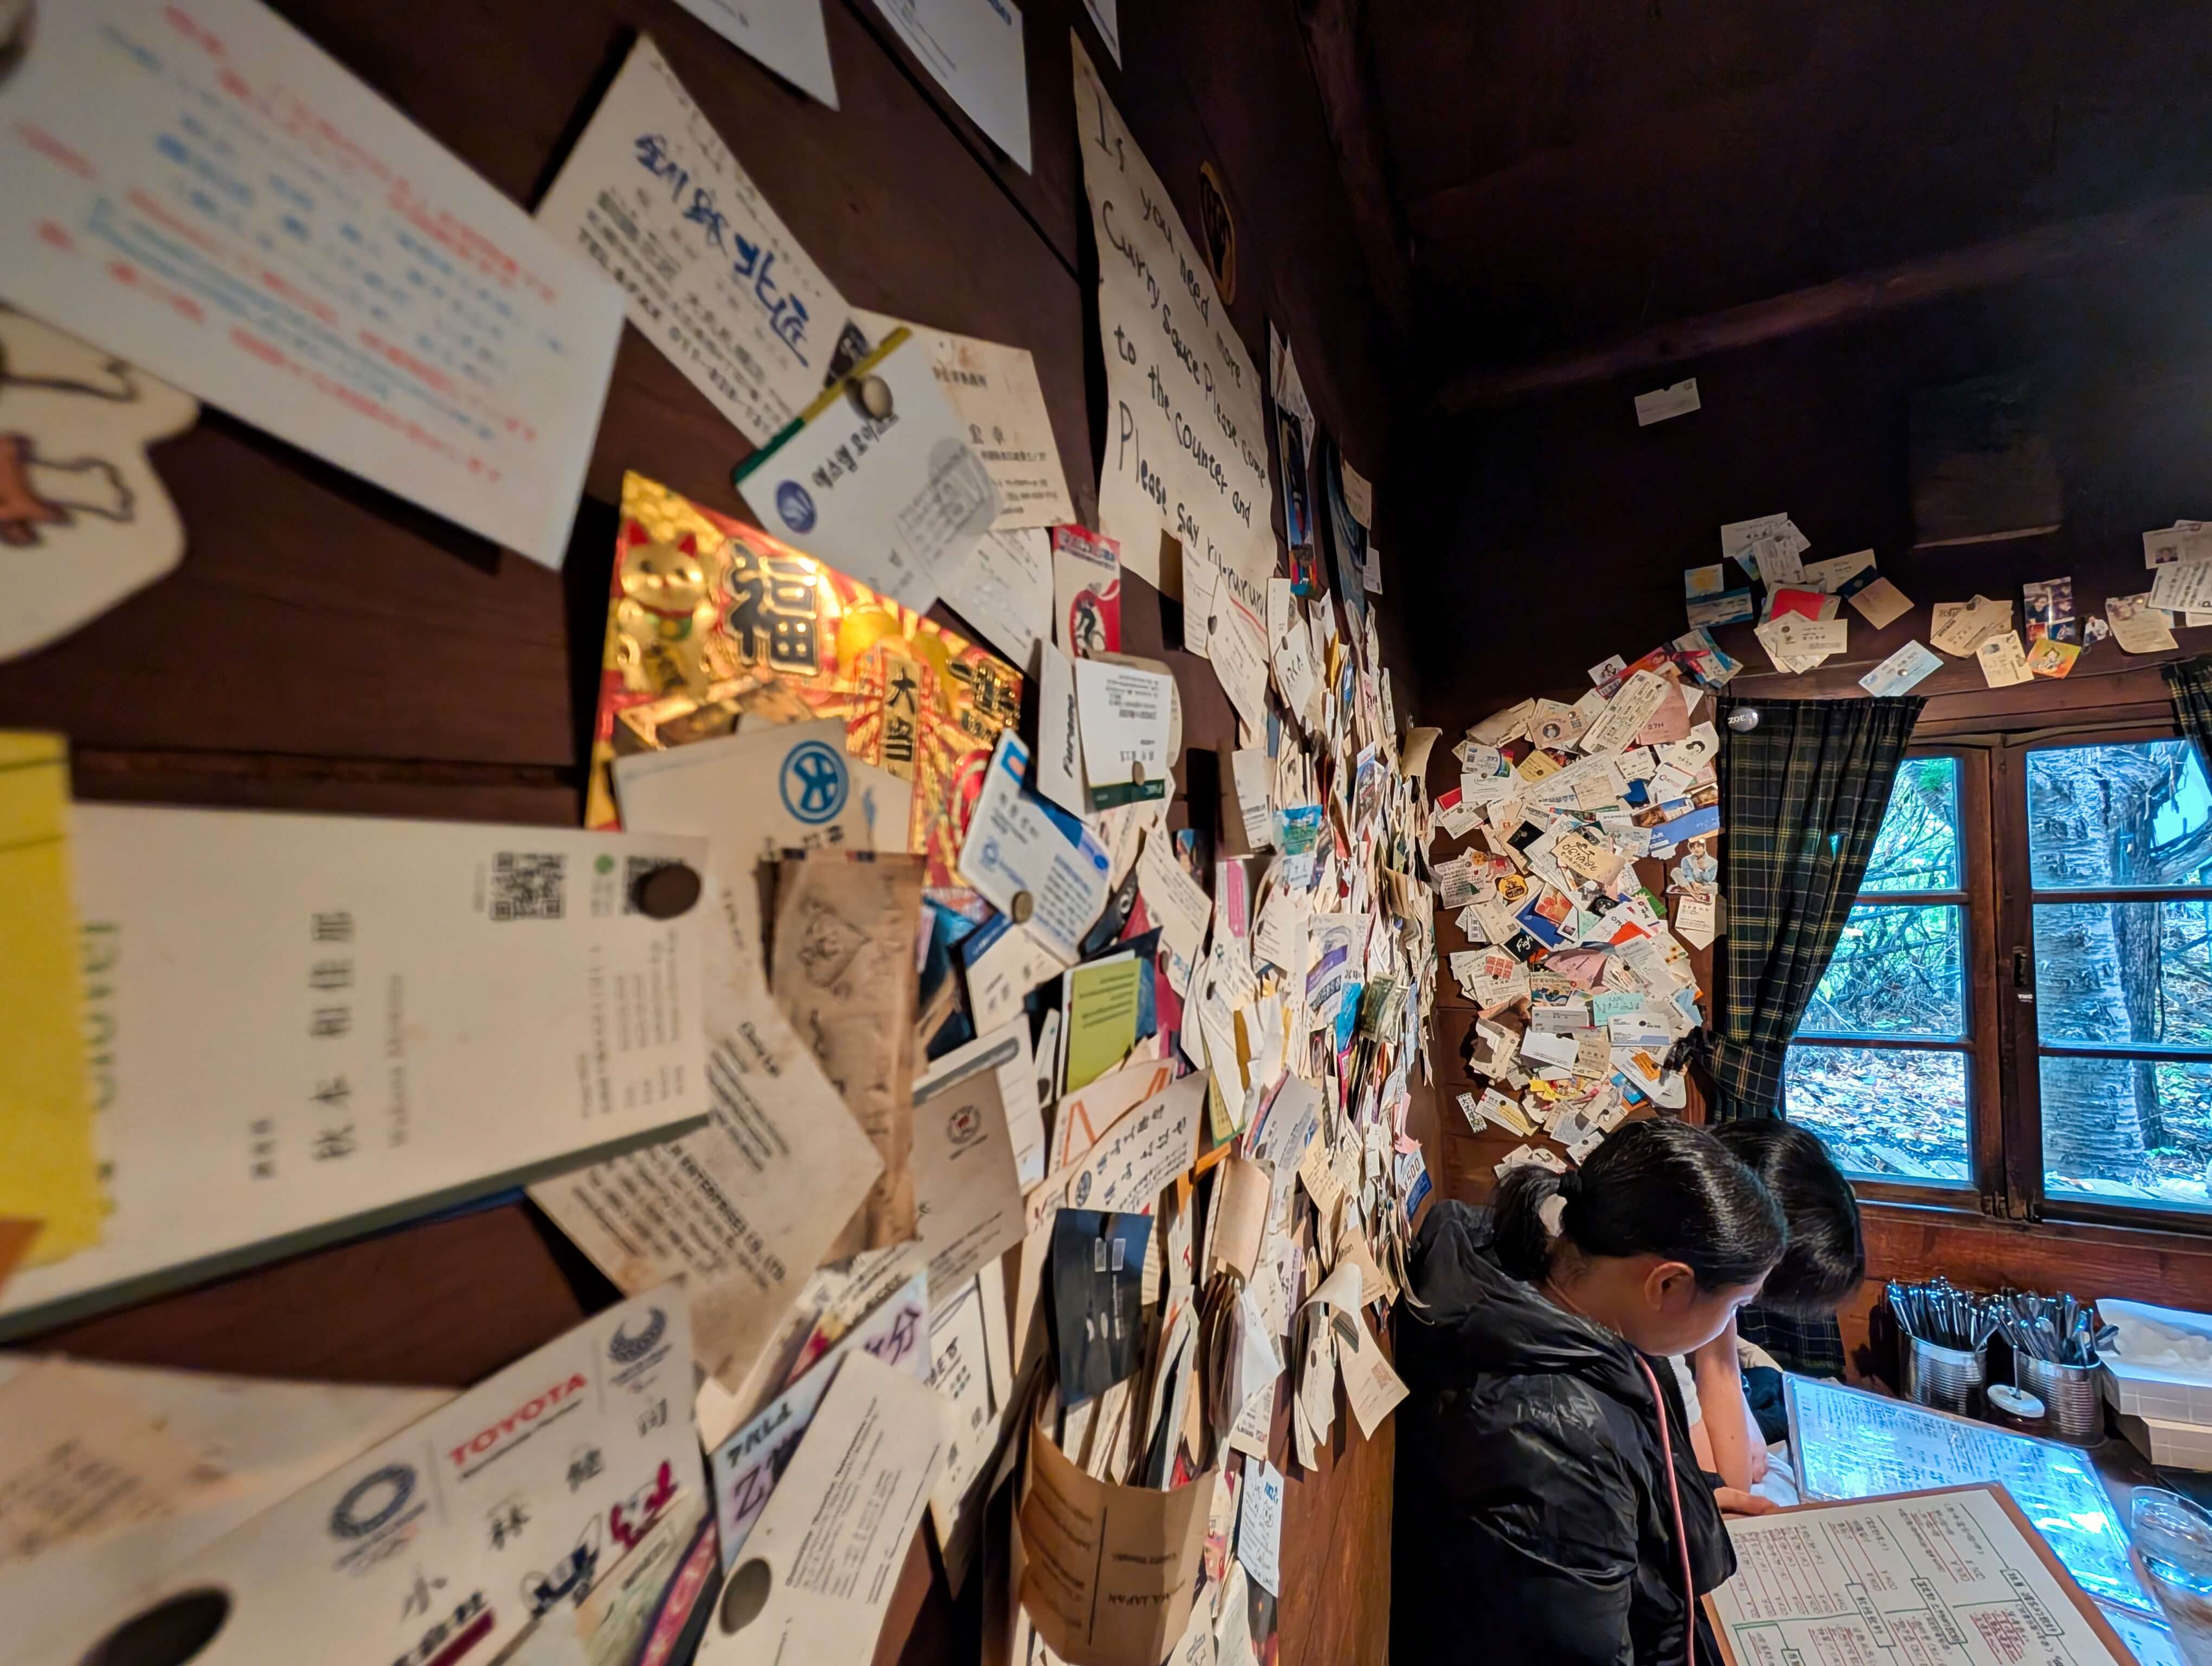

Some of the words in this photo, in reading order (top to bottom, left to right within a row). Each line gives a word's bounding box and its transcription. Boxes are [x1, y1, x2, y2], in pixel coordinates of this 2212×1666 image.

[1103, 200, 1160, 310] Curry
[1140, 187, 1175, 254] you
[1180, 251, 1210, 328] need
[1114, 324, 1136, 366] to
[1147, 364, 1171, 421] the
[1232, 490, 1252, 529] and
[1118, 399, 1168, 516] Please
[1648, 722, 1664, 730] 27H
[1516, 934, 1534, 953] Figh
[447, 1372, 588, 1466] TOYOTA
